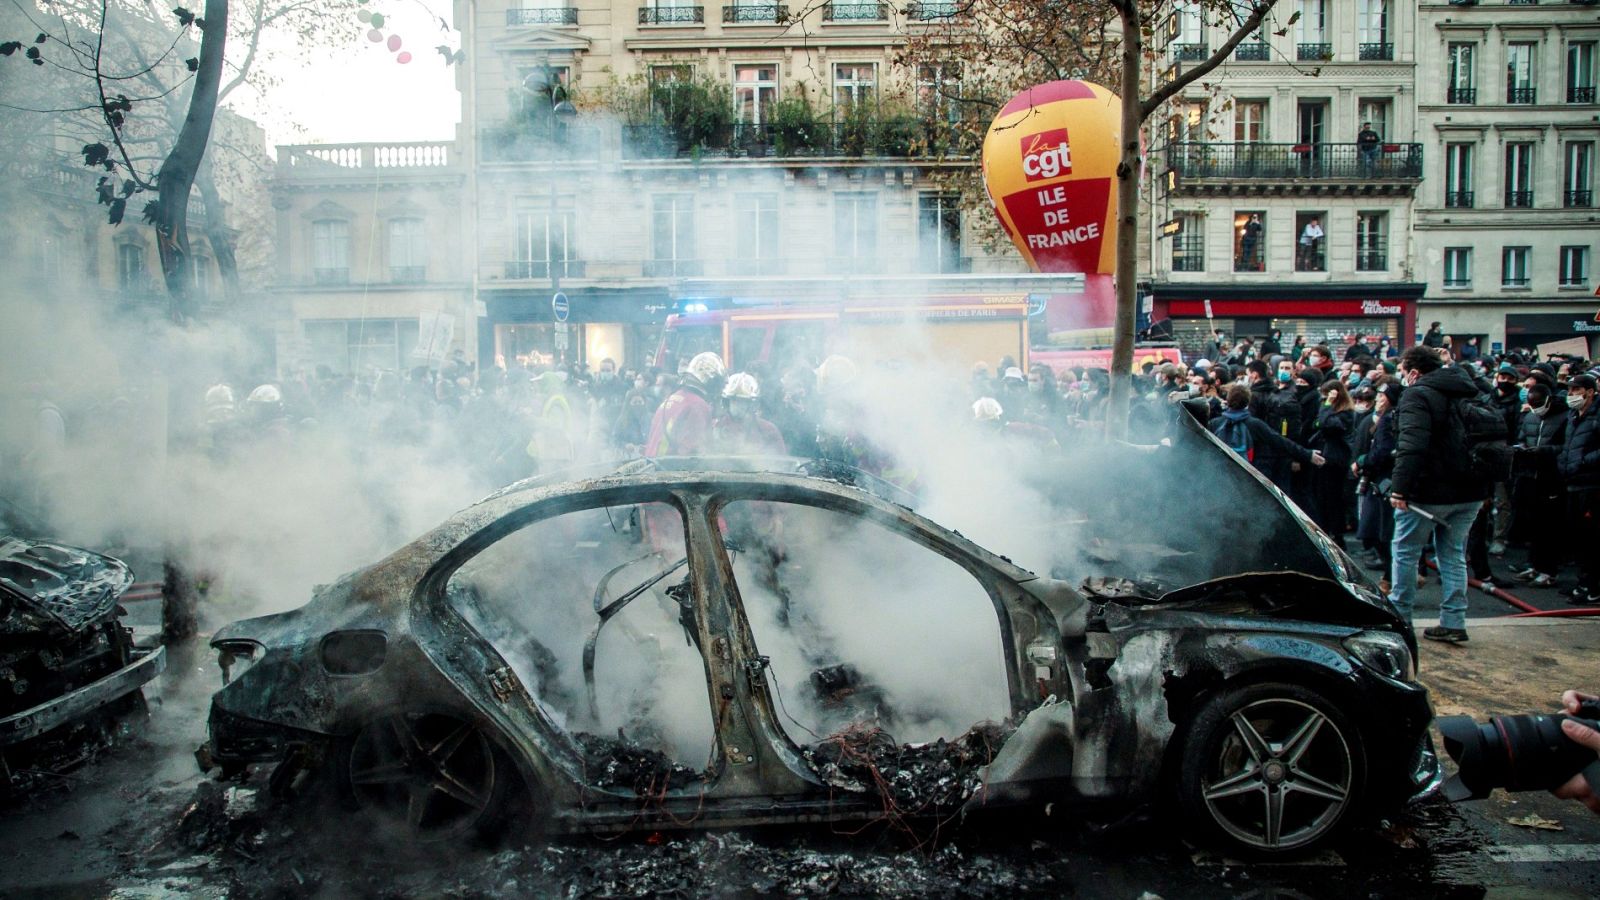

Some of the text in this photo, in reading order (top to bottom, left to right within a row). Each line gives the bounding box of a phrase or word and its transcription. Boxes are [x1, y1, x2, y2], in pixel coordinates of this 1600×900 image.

[1023, 142, 1072, 178] cgt
[1037, 186, 1067, 206] ILE
[1043, 208, 1070, 227] DE
[1027, 222, 1100, 249] FRANCE
[983, 296, 1025, 304] GIMAEX
[1364, 306, 1401, 314] BEUSCHER
